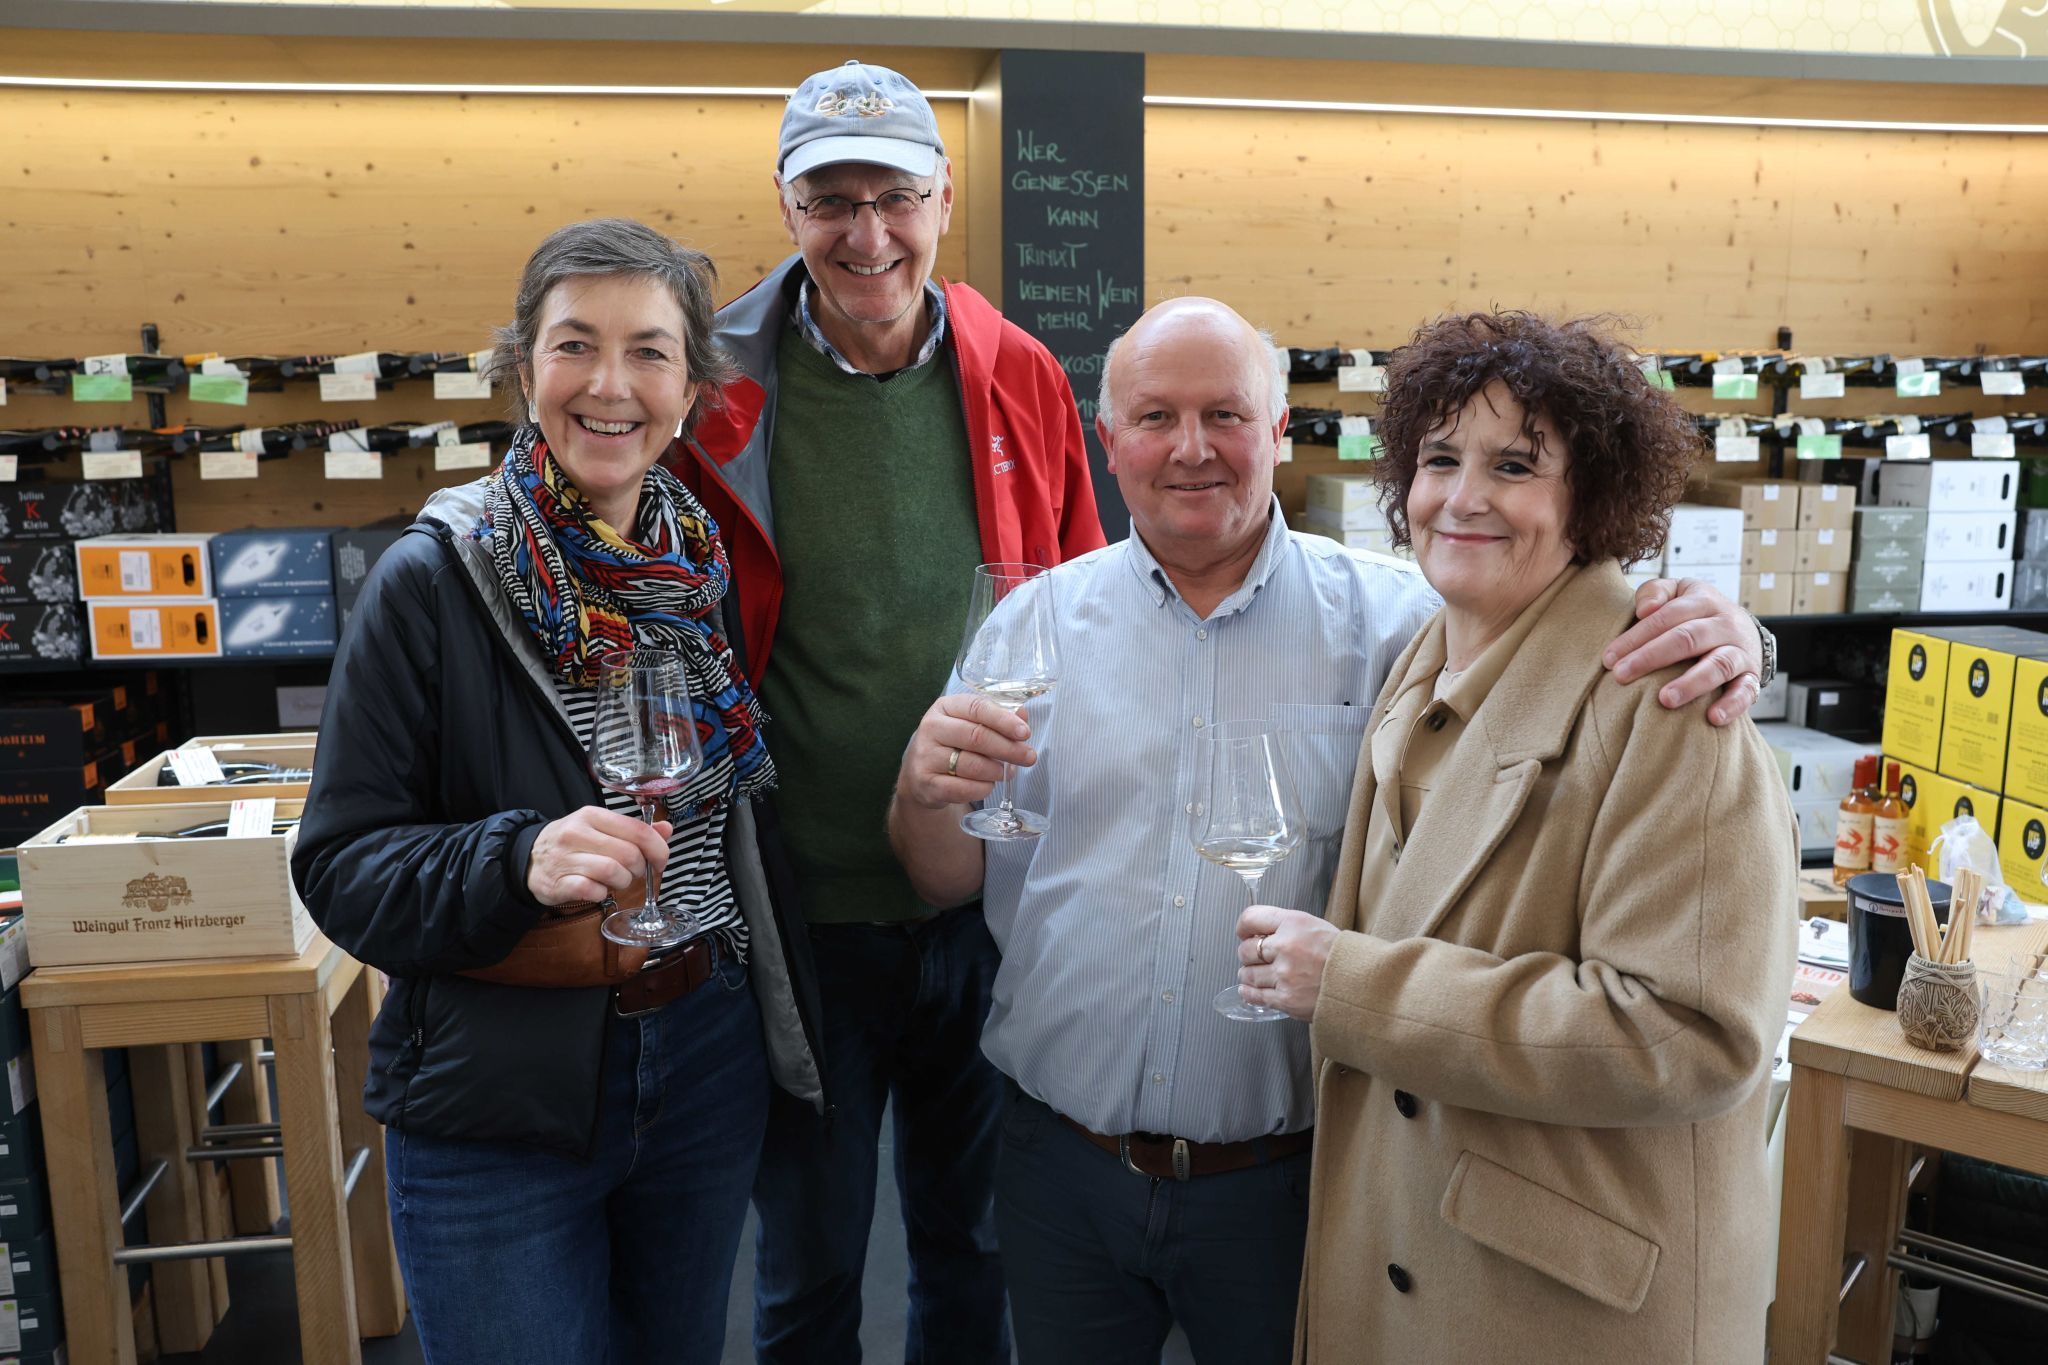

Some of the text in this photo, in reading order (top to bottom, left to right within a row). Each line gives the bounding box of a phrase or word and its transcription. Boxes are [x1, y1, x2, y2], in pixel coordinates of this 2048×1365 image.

[1017, 129, 1066, 163] WER
[1012, 170, 1128, 197] GENIESSEN
[1047, 205, 1098, 229] KANN
[1097, 269, 1138, 320] WEIN
[1037, 312, 1093, 331] MEHR
[18, 491, 45, 502] Julius
[25, 502, 41, 519] K
[23, 520, 49, 530] Klein
[72, 914, 246, 934] Weingut Franz Hirtzberger
